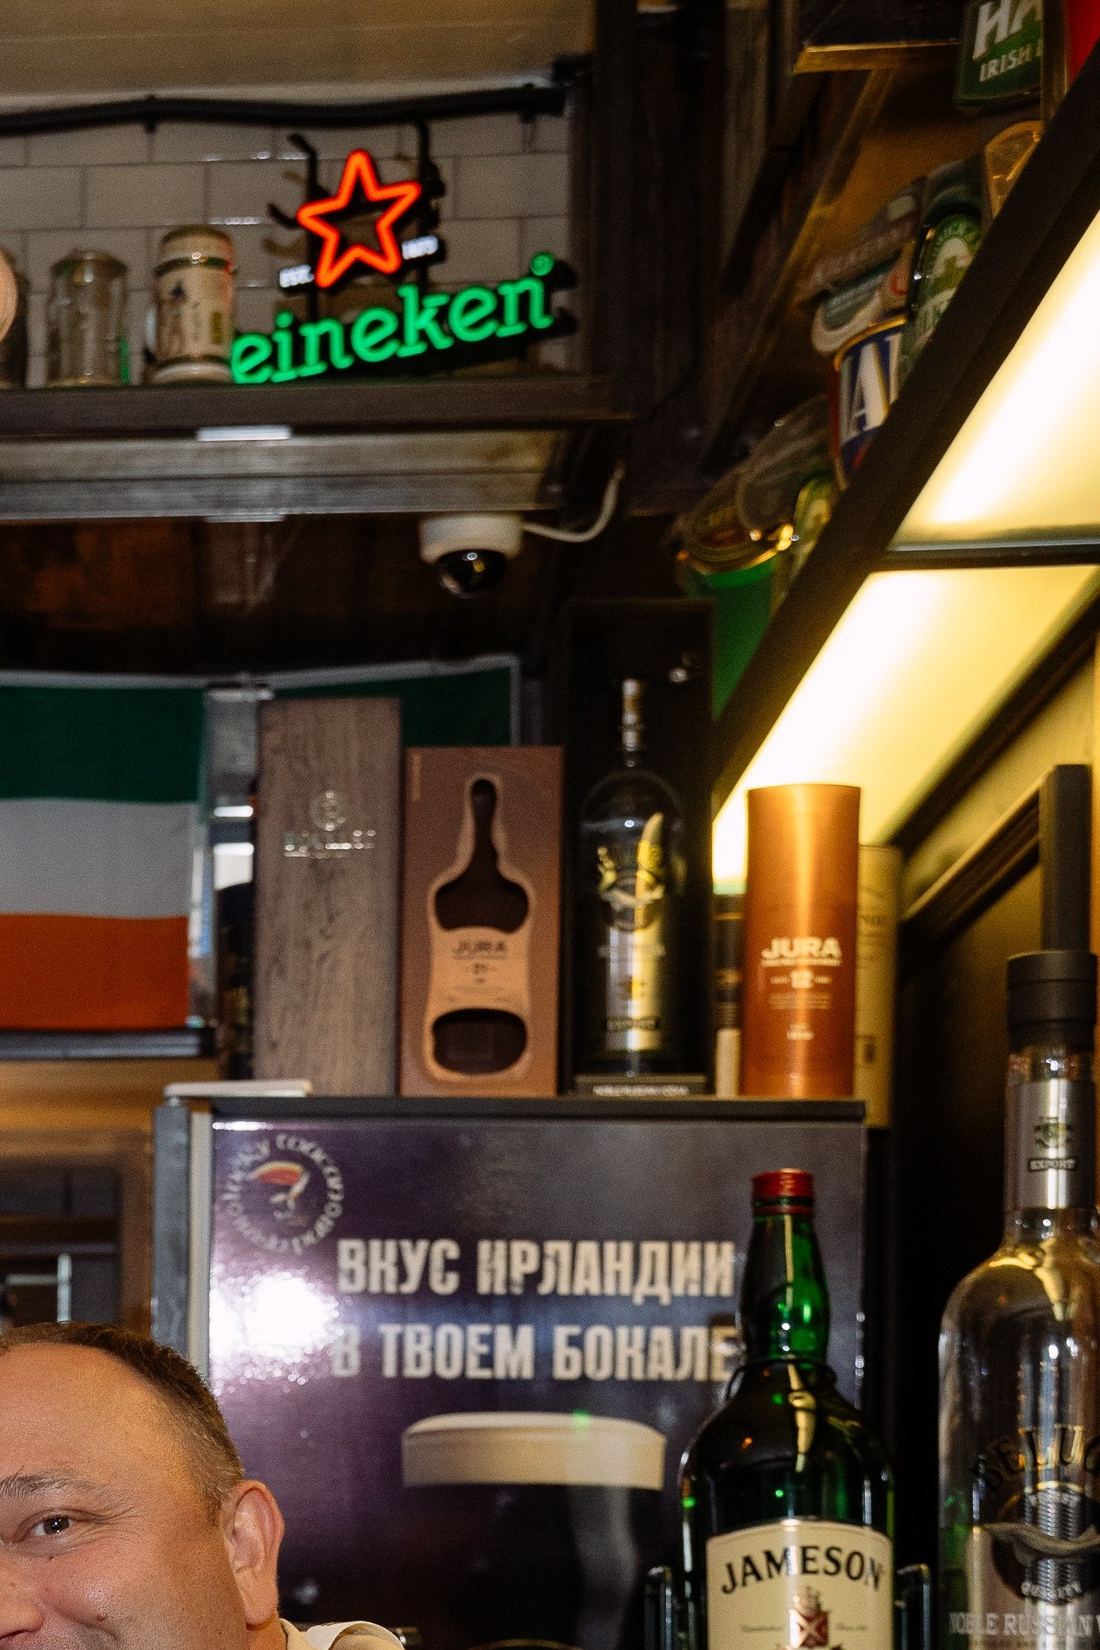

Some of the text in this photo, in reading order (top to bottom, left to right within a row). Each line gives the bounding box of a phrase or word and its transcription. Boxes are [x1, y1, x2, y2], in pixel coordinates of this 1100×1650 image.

[230, 270, 555, 384] eineken
[761, 937, 842, 959] JURA
[336, 1238, 736, 1305] ВКУС ИРЛАНДИИ
[331, 1323, 739, 1381] В ТВОЕМ БОКАЛЕ
[721, 1545, 883, 1594] JAMESON
